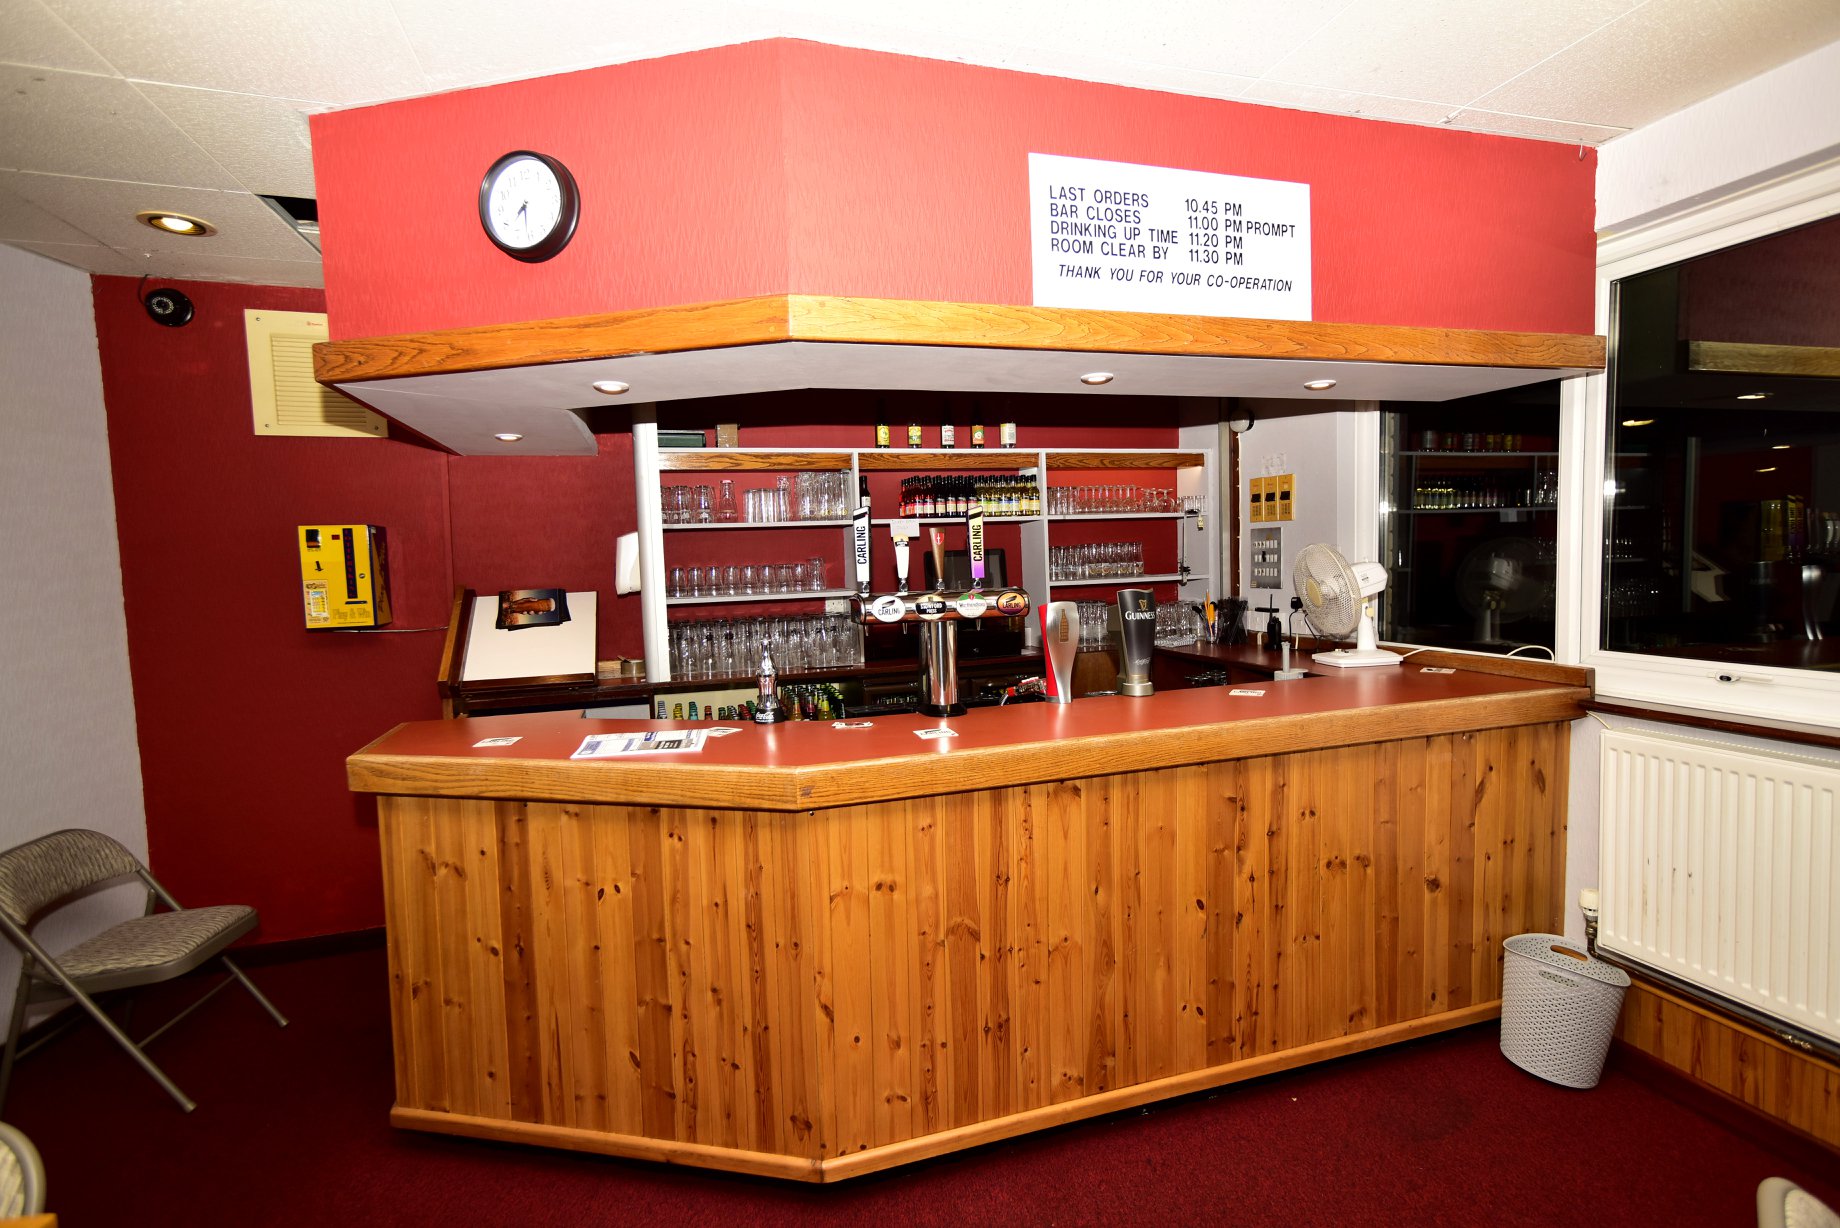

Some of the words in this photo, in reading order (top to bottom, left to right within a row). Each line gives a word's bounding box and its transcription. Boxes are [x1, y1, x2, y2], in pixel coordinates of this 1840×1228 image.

[1049, 185, 1086, 202] LAST
[1093, 189, 1149, 208] ORDERS
[1184, 199, 1218, 215] 10.45
[1224, 203, 1242, 217] PM
[1050, 203, 1079, 219] BAR
[1086, 206, 1141, 225] CLOSES
[1187, 216, 1219, 232] 11.00
[1224, 219, 1243, 234] PM
[1246, 221, 1296, 238] PROMPT
[1050, 221, 1117, 240] DRINKING
[1123, 227, 1141, 241] UP
[1148, 229, 1179, 245] TIME
[1188, 233, 1219, 248] 11.20
[1225, 235, 1243, 250] PM
[1051, 238, 1094, 255] ROOM
[1100, 242, 1146, 259] CLEAR
[1152, 246, 1169, 260] BY
[1188, 249, 1219, 265] 11.30
[1225, 252, 1243, 266] PM
[1059, 264, 1102, 280] THANK
[1110, 268, 1134, 282] YOU
[1139, 270, 1164, 284] FOR
[1171, 272, 1202, 286] YOUR
[1206, 275, 1293, 292] CO-OPERATION
[856, 525, 868, 565] CARLING
[971, 524, 983, 562] CARLING
[877, 608, 901, 616] CARLING
[1125, 610, 1156, 620] GUINNESS
